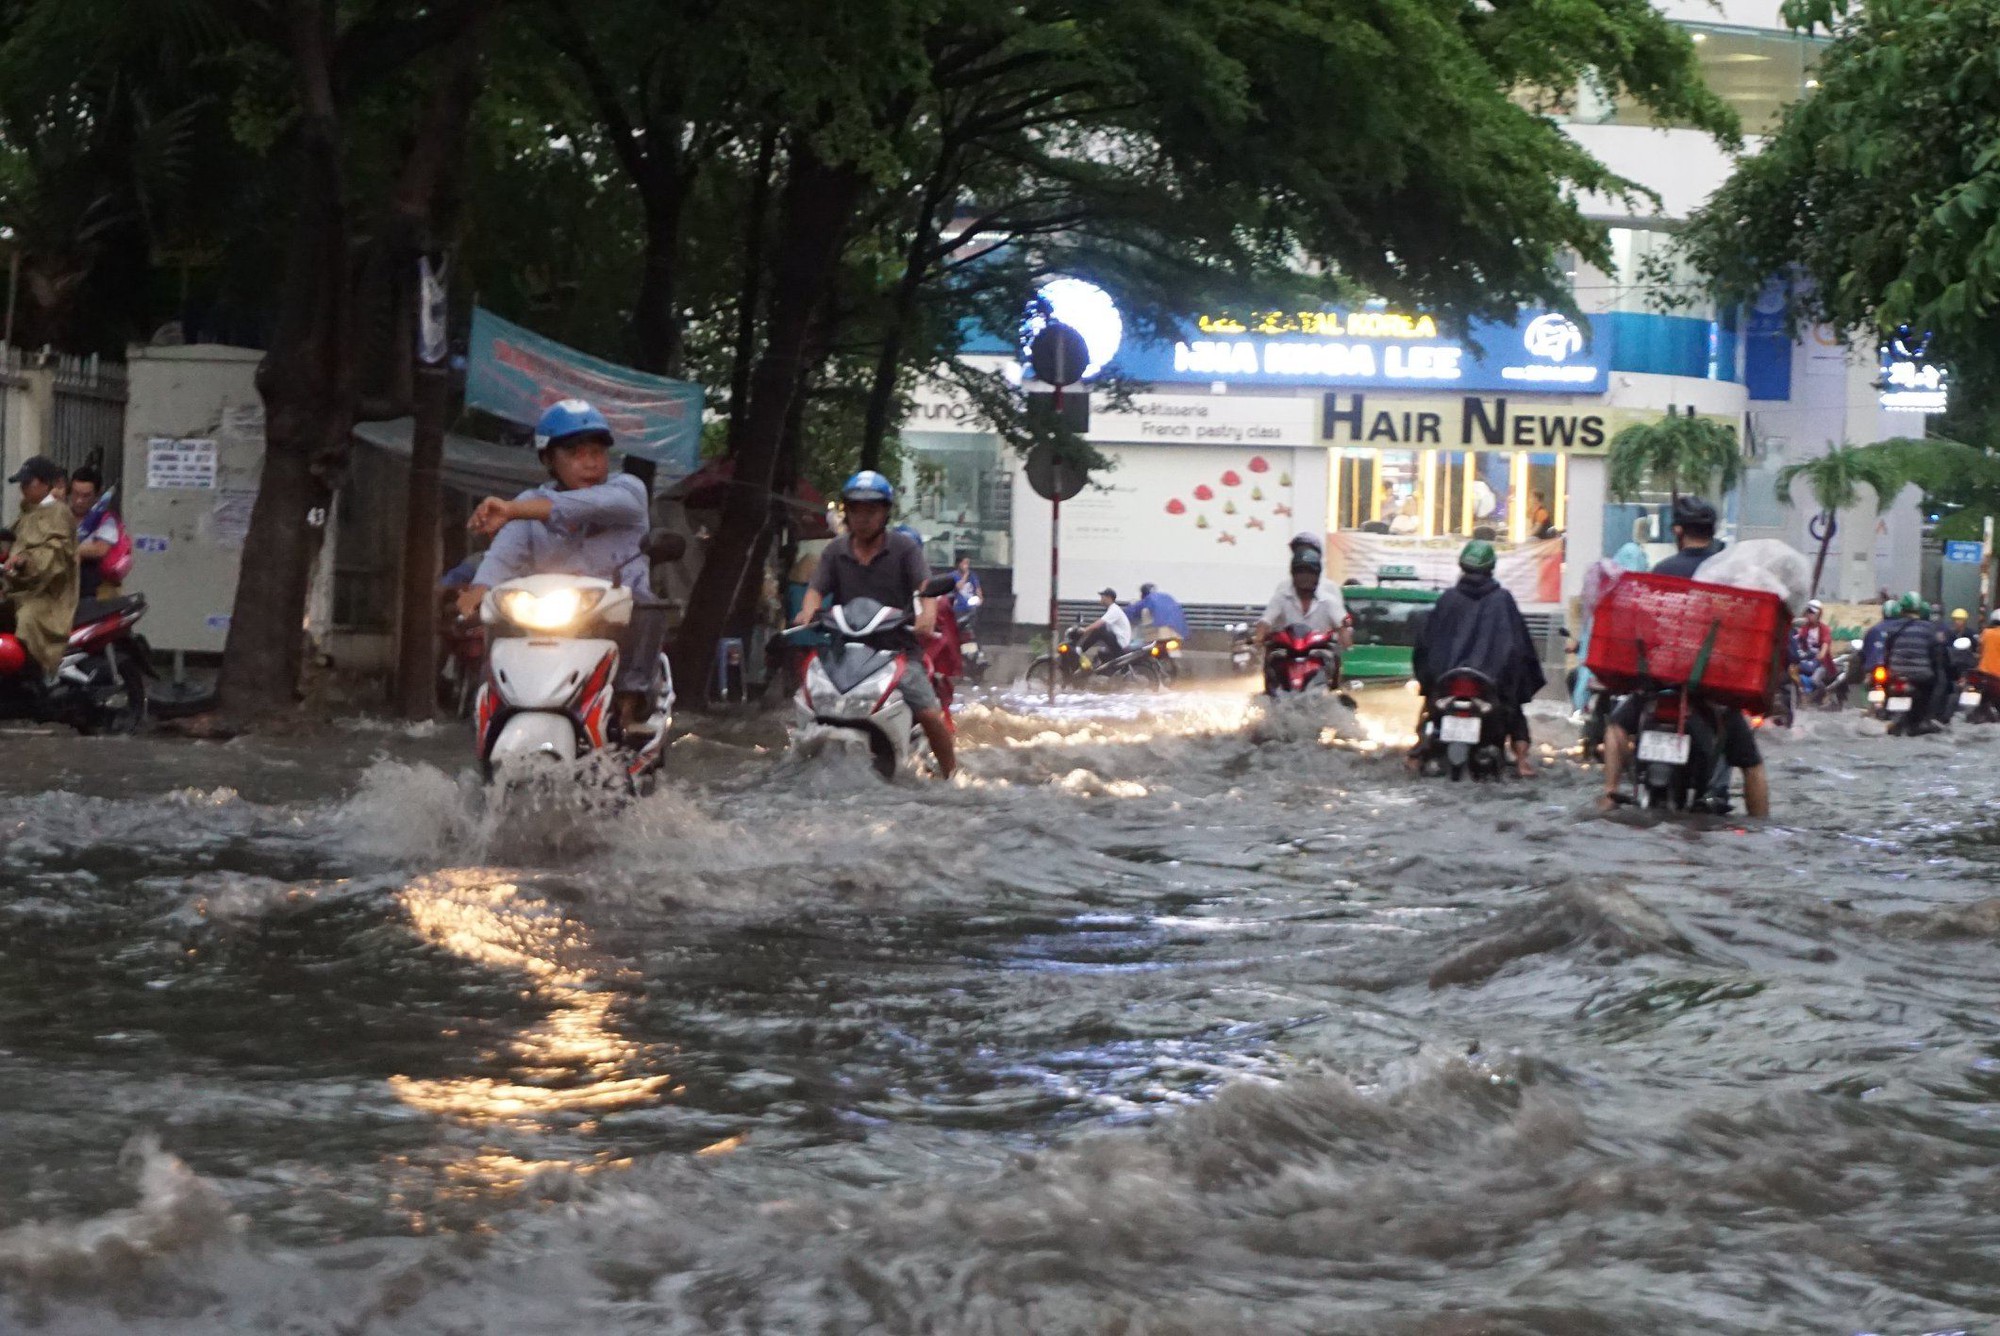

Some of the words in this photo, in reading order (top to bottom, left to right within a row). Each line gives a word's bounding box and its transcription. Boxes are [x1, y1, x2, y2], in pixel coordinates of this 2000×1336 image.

[1347, 313, 1436, 338] KOREA
[1384, 346, 1462, 379] LEE
[1142, 421, 1190, 436] French
[1196, 423, 1243, 440] pastry
[1246, 424, 1282, 438] class
[1321, 392, 1441, 444] HAIR
[1461, 396, 1605, 447] NEWS
